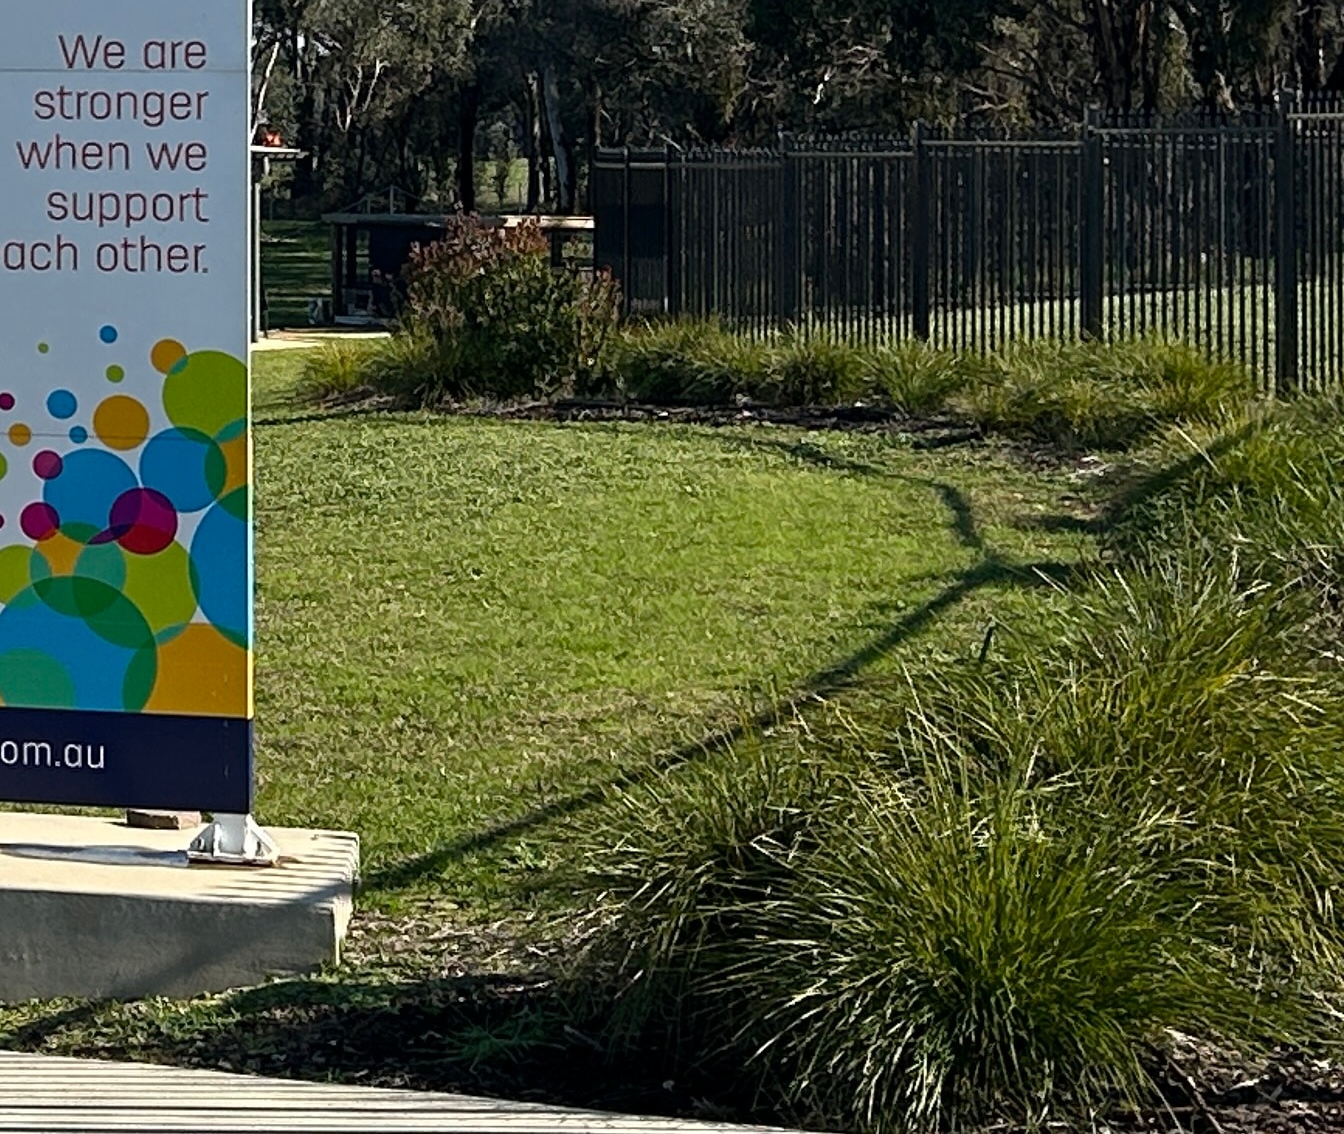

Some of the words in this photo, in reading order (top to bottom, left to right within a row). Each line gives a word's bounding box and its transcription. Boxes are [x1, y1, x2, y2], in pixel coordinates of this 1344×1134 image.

[57, 34, 127, 70] We
[143, 40, 208, 70] are
[34, 85, 210, 128] stronger
[15, 132, 131, 171] when
[145, 142, 208, 172] we
[46, 187, 210, 229] support
[96, 234, 210, 274] other.
